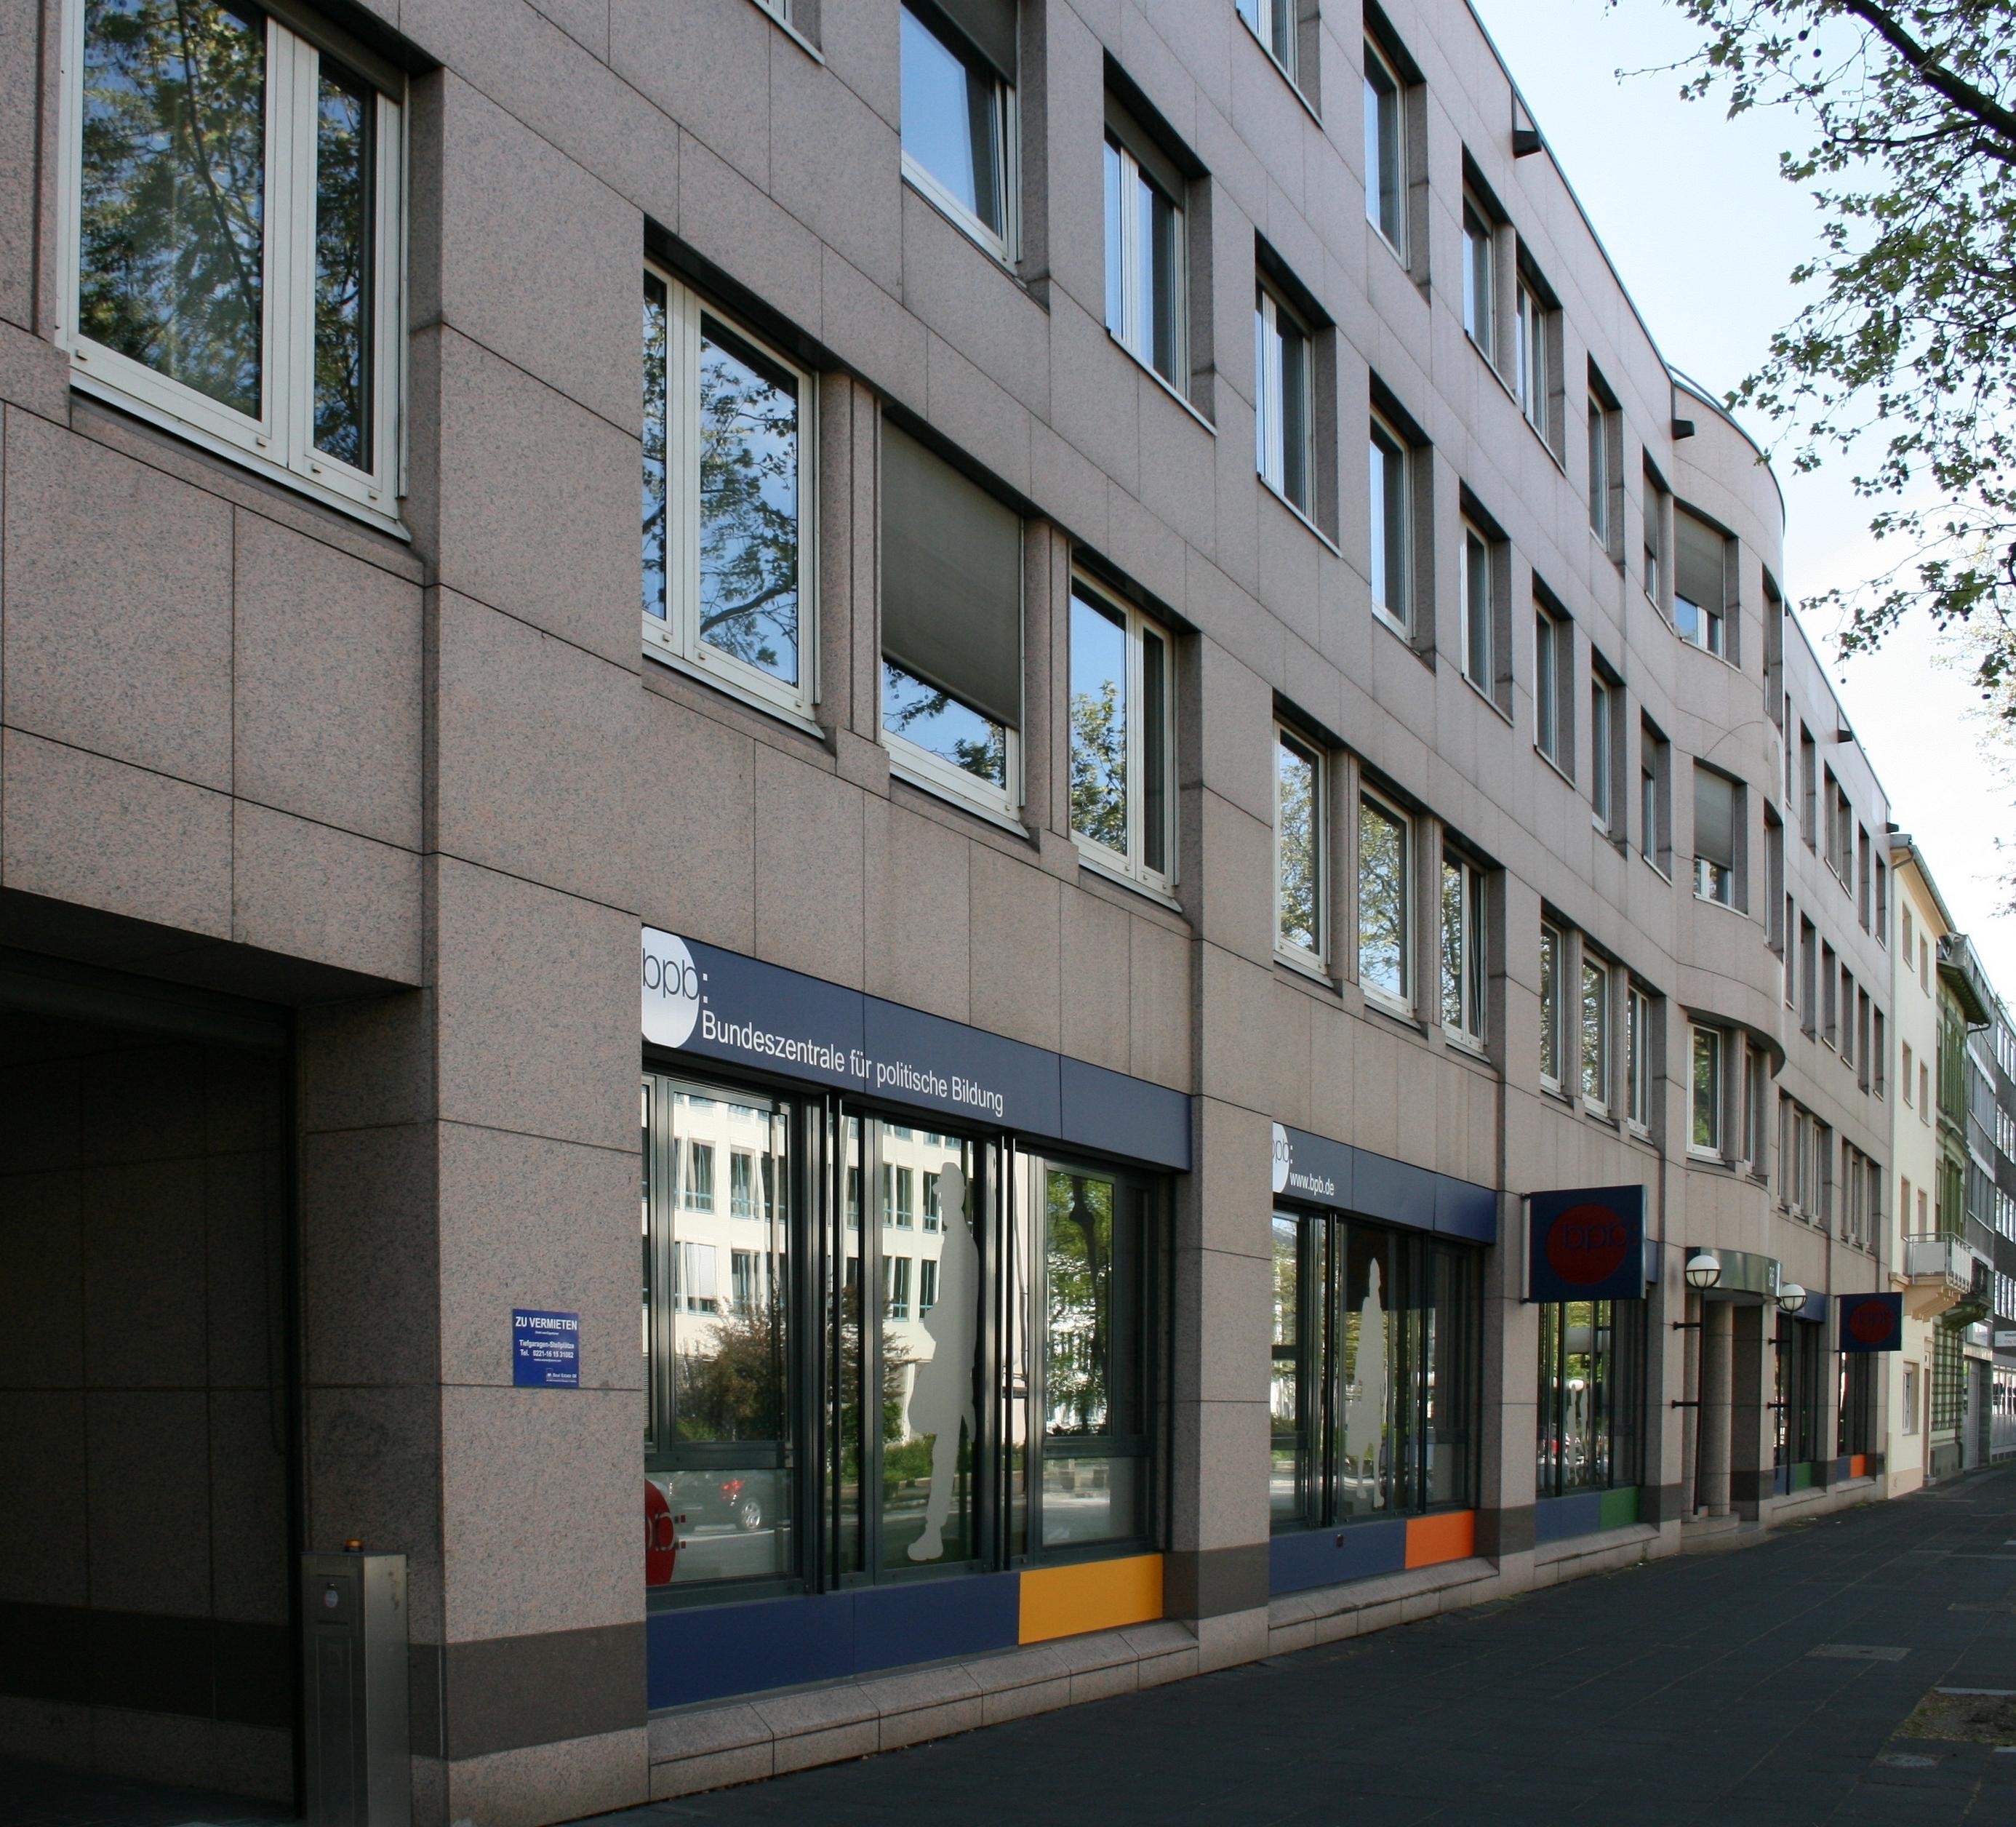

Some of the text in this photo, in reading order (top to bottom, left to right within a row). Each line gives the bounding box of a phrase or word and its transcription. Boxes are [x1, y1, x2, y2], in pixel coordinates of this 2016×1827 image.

[643, 948, 708, 1004] bpb:
[702, 1010, 1004, 1118] Bundeszentrale für politische Bildung
[1272, 1139, 1293, 1164] pb:
[1289, 1172, 1335, 1196] www.bpb.de
[515, 1316, 577, 1331] ZU VERMIETEN
